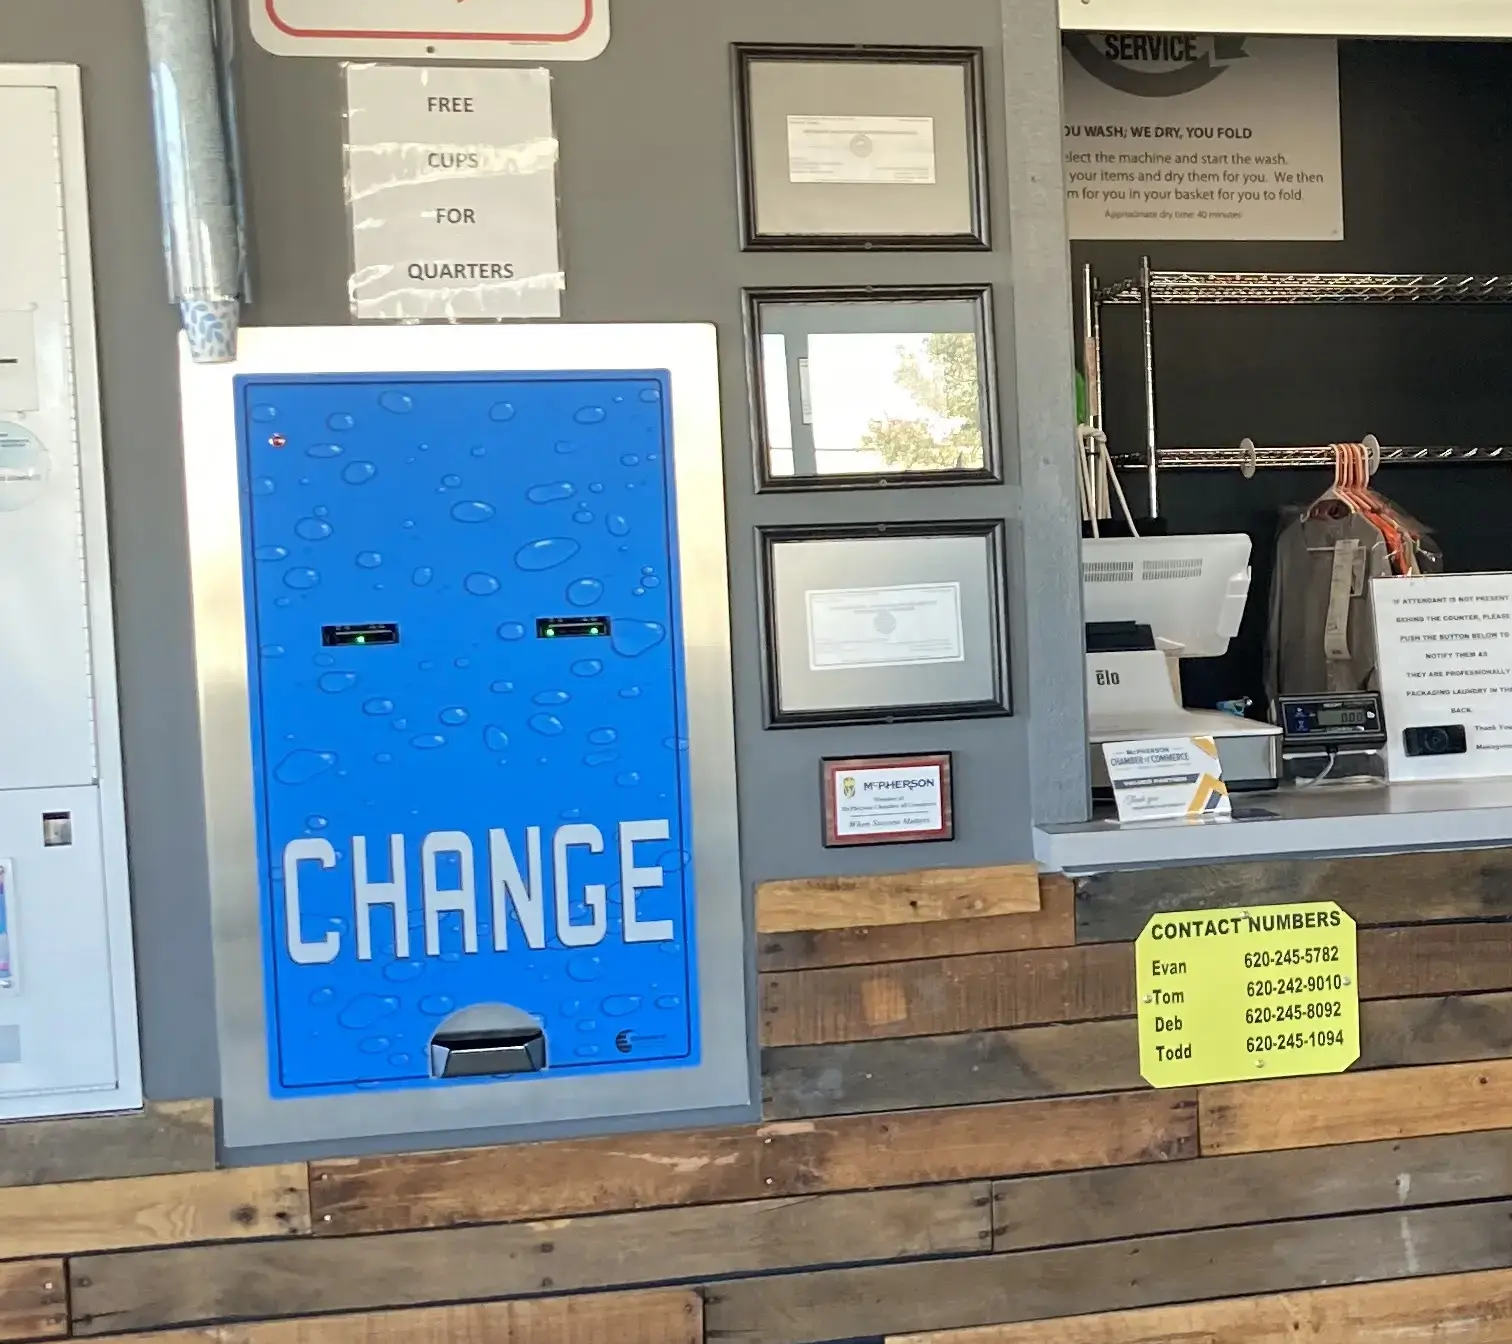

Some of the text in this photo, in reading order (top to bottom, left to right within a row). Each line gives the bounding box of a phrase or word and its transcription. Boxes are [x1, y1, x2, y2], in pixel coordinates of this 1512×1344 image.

[426, 97, 474, 113] FREE
[1085, 125, 1127, 139] WASH;
[1130, 126, 1152, 138] WE
[1155, 127, 1182, 139] DRY,
[1186, 127, 1213, 138] YOU
[1217, 127, 1252, 139] FOLD
[428, 152, 479, 169] CUPS
[1095, 151, 1115, 163] the
[1119, 152, 1172, 164] machine
[1175, 152, 1198, 164] and
[1201, 154, 1228, 164] start
[1232, 153, 1251, 164] the
[1069, 172, 1097, 184] your
[1101, 170, 1134, 181] items
[1138, 170, 1161, 181] and
[1164, 170, 1185, 184] dry
[1188, 170, 1219, 182] them
[1223, 170, 1239, 182] for
[1274, 171, 1293, 183] We
[1297, 170, 1324, 183] then
[1082, 186, 1098, 199] for
[1102, 190, 1126, 202] you
[1129, 188, 1140, 199] in
[1144, 190, 1172, 203] your
[1175, 188, 1214, 200] basket
[1218, 188, 1234, 200] for
[1238, 191, 1260, 203] you
[1264, 190, 1276, 201] to
[436, 208, 475, 224] FOR
[407, 263, 513, 281] QUARTERS
[282, 819, 674, 966] CHANGE
[1151, 910, 1341, 940] CONTACT NUMBERS
[1152, 946, 1339, 976] Evan 620-245-5782
[1153, 974, 1341, 1005] Tom 620-242-9010
[1155, 1001, 1341, 1032] Deb 620-245-8092
[1156, 1030, 1344, 1062] Todd 620-245-1094
